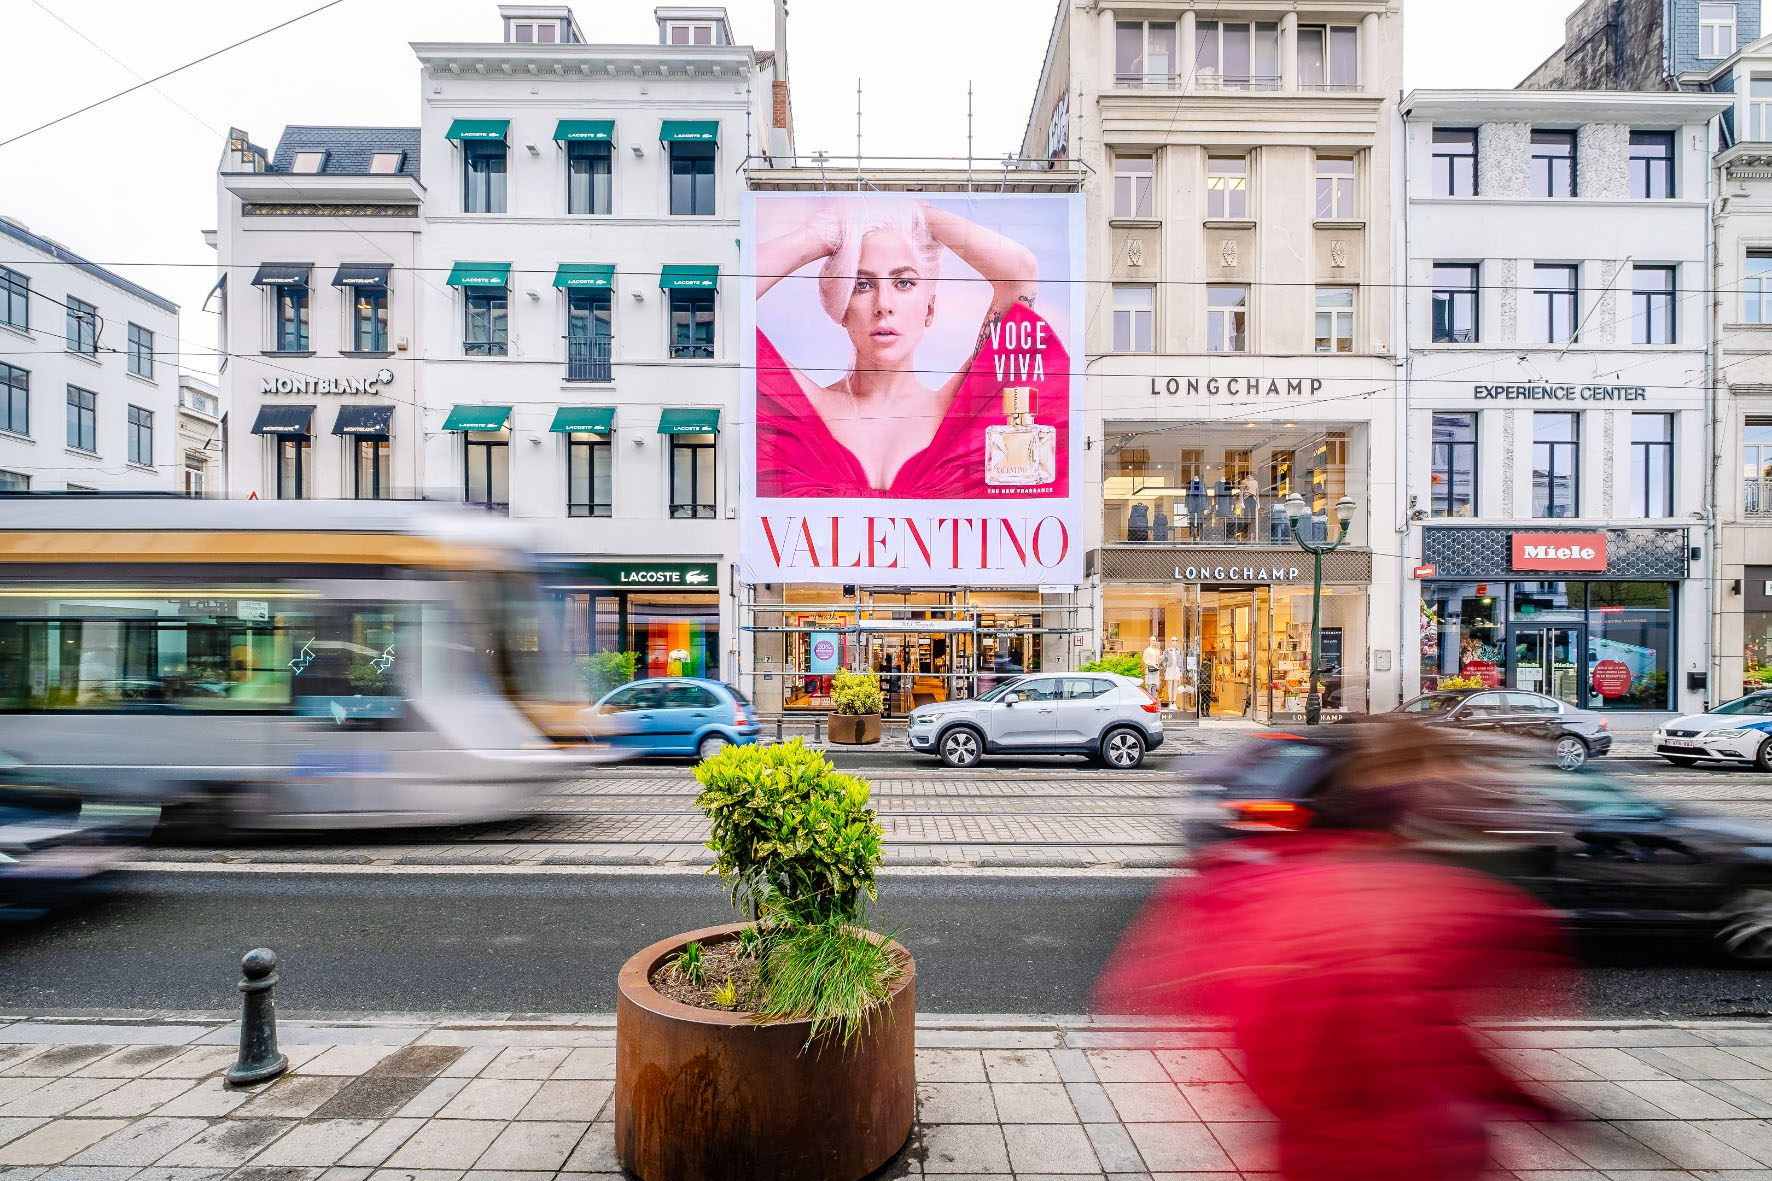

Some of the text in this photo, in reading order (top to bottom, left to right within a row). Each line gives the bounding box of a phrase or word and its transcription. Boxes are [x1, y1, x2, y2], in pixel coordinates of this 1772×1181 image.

[990, 321, 1047, 350] VOCE
[994, 353, 1045, 382] VIVA
[261, 377, 379, 394] MONTBLANC
[1151, 377, 1323, 396] LONGCHAMP
[1473, 385, 1647, 401] EXPERIENCE CENTER
[755, 515, 1069, 570] VALENTINO
[1523, 545, 1596, 560] Miele
[621, 571, 681, 582] LACOSTE
[1174, 566, 1299, 580] LONGCHAMP
